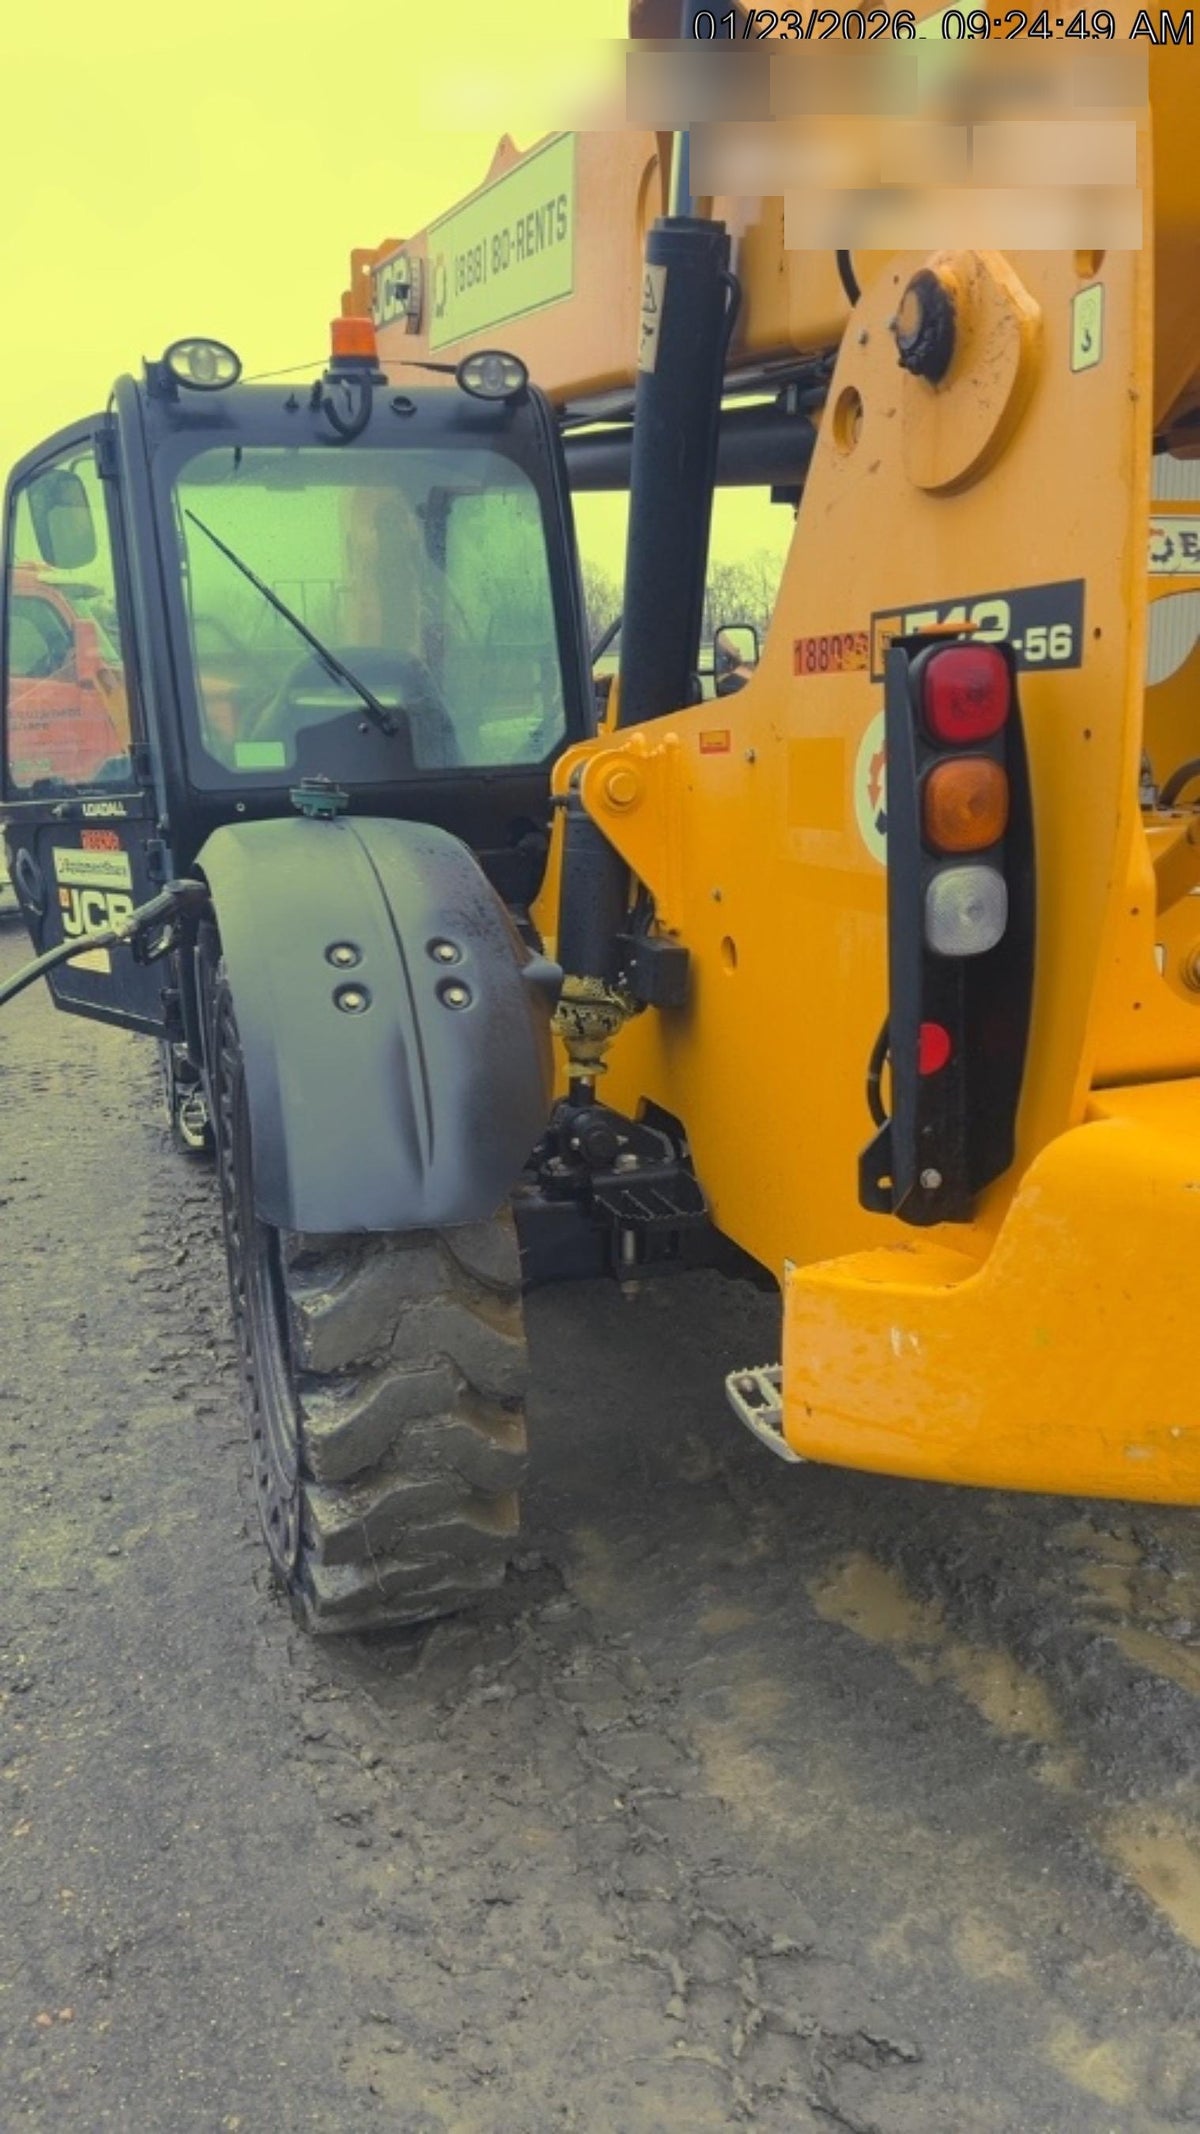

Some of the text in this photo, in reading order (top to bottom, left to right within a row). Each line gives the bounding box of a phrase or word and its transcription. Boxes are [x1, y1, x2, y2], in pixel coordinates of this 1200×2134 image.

[491, 193, 568, 276] 80-RENTS
[82, 801, 128, 817] LOADALL
[61, 888, 134, 937] JCB
